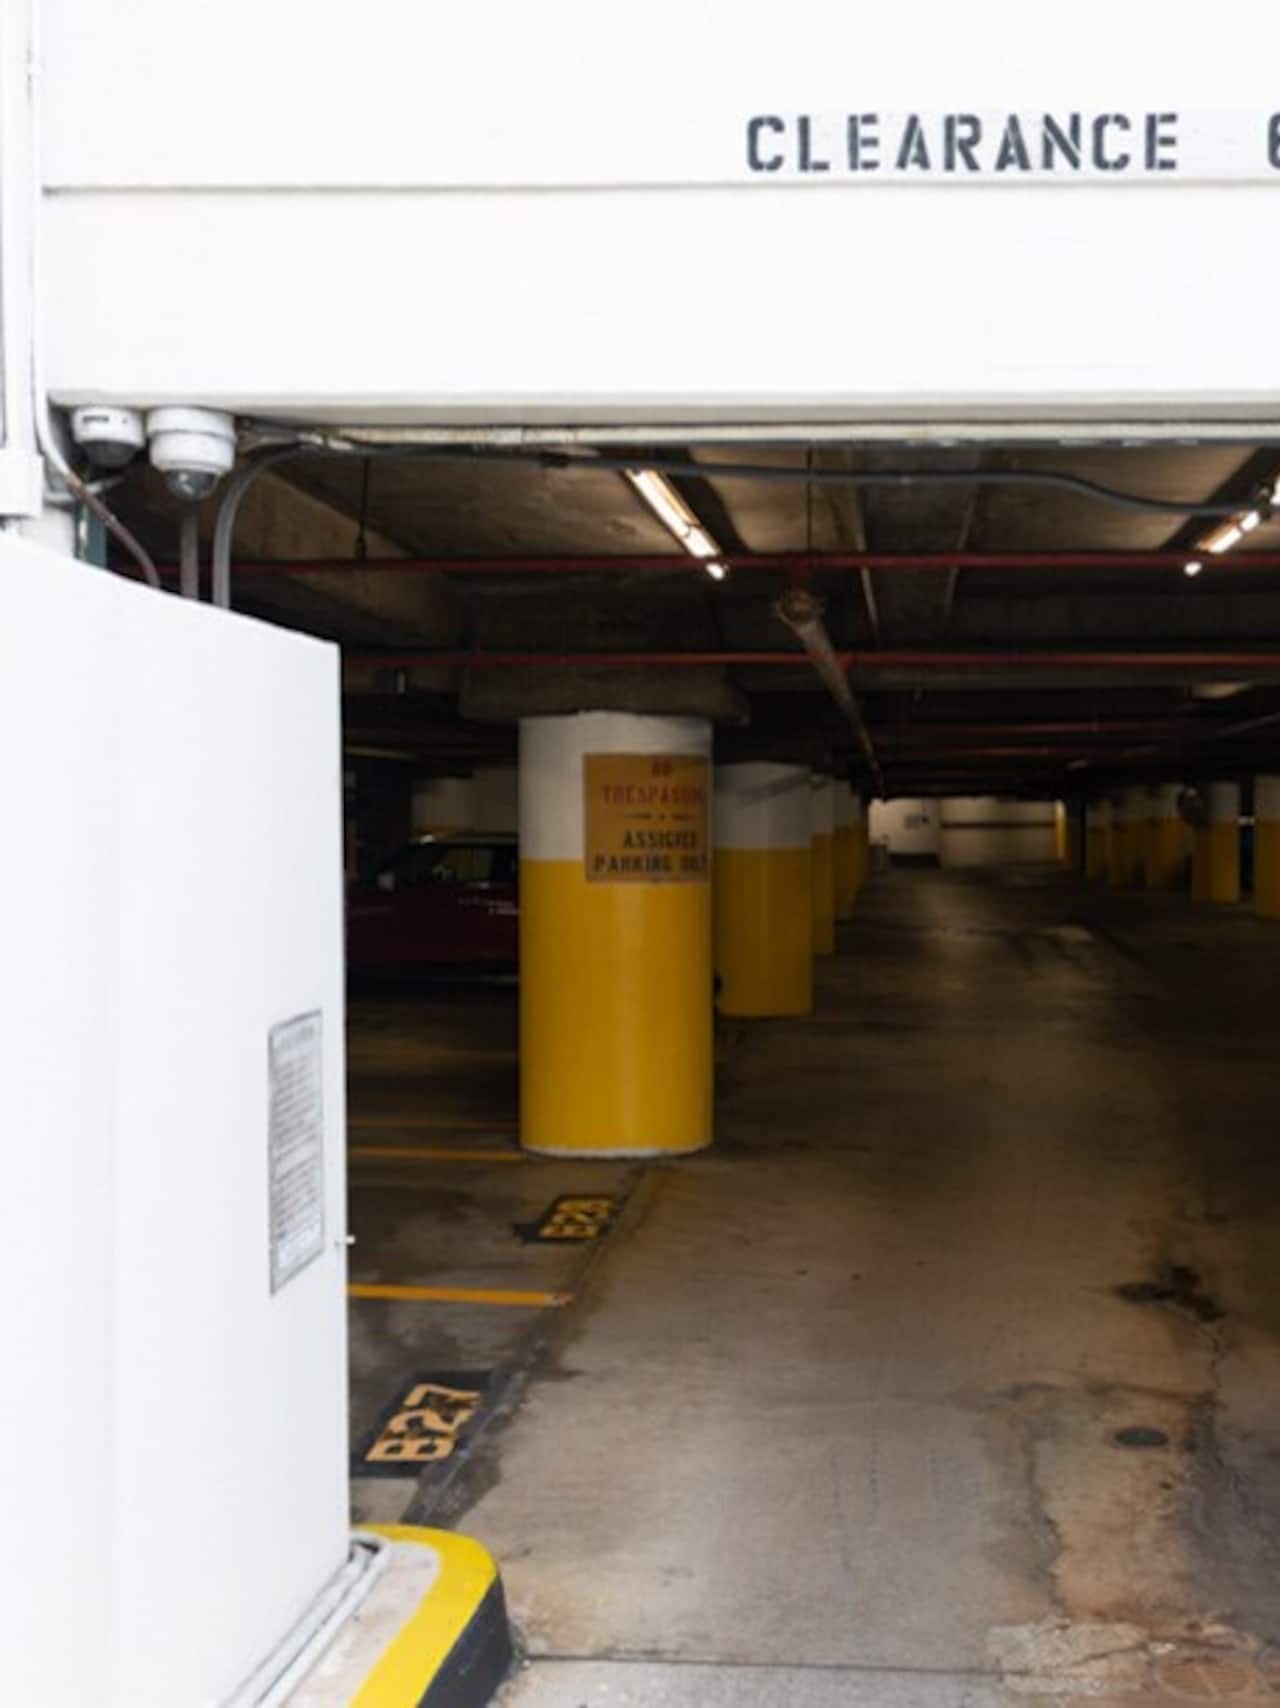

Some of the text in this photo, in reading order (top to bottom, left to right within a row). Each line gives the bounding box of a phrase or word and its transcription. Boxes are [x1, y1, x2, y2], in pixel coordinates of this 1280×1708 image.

[746, 113, 1178, 172] CLEARANCE
[594, 855, 672, 872] PARKING
[363, 1382, 481, 1461] B27
